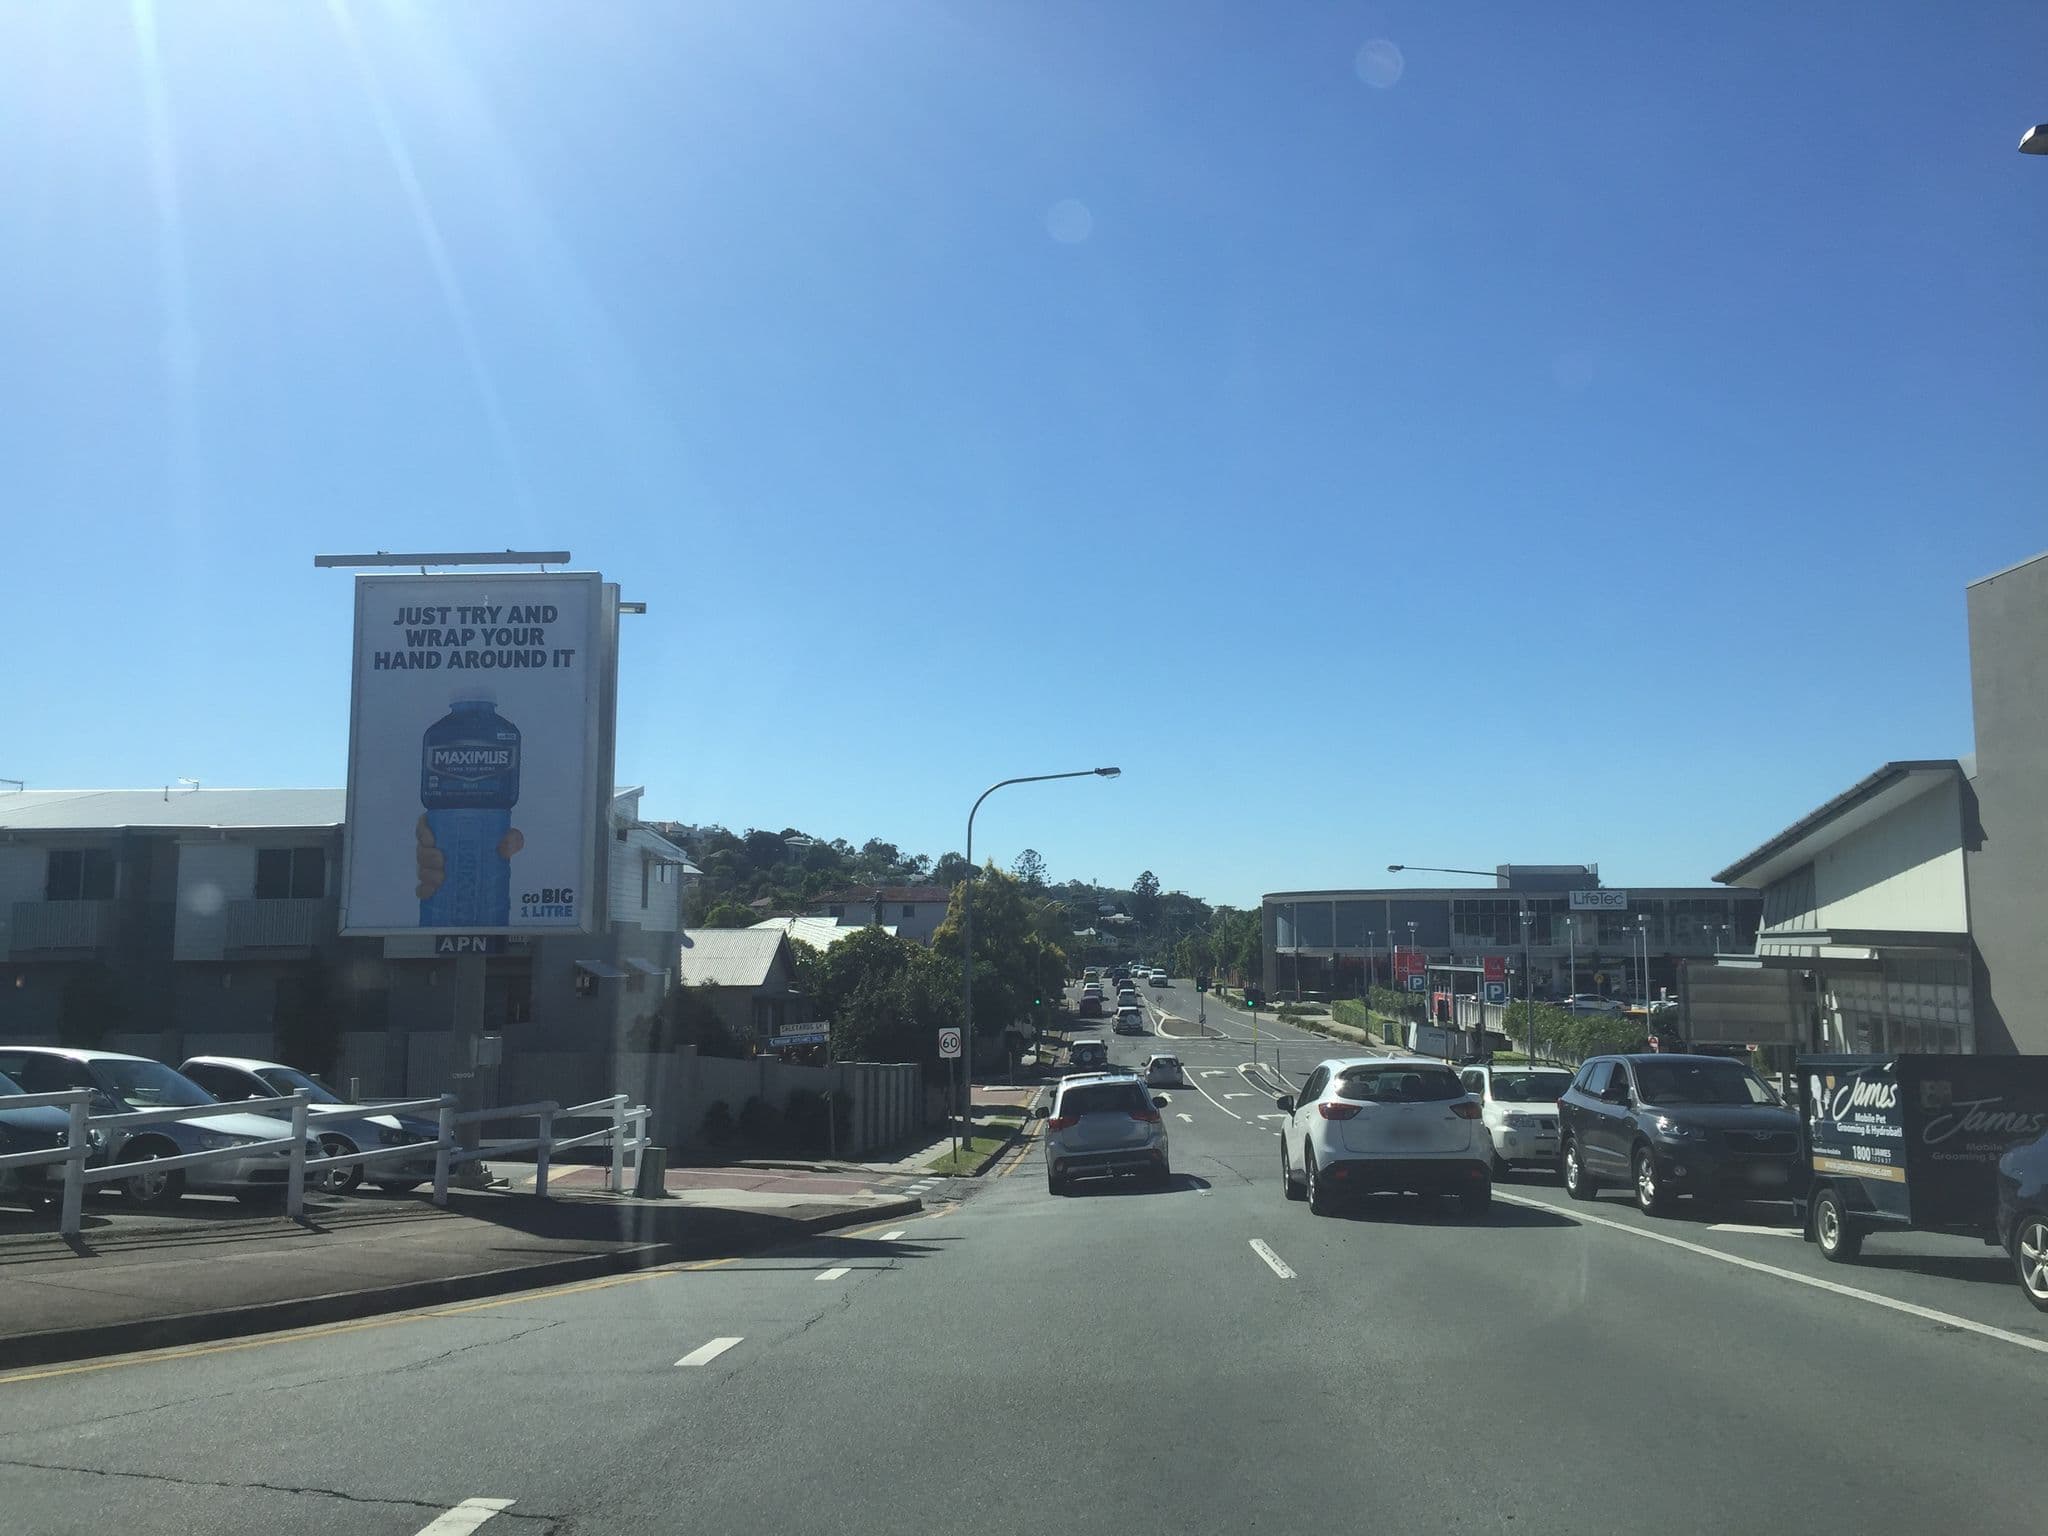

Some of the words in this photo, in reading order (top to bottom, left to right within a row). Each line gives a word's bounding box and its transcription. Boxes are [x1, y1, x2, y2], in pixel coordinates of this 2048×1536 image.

[393, 606, 452, 626] JUST
[456, 606, 503, 625] TRY
[507, 605, 559, 624] AND
[405, 628, 476, 647] WRAP
[481, 627, 545, 646] YOUR
[374, 651, 442, 670] HAND
[447, 649, 547, 670] AROUND
[552, 649, 576, 668] IT
[434, 750, 509, 765] MAXIMUS
[521, 893, 540, 904] GO
[541, 887, 574, 904] BIG
[1573, 891, 1625, 905] LifeTec
[520, 905, 529, 918] 1
[532, 905, 574, 917] LITRE
[439, 936, 488, 952] APN
[942, 1037, 958, 1048] 60
[1832, 1074, 1898, 1121] James
[1854, 1112, 1875, 1123] Mobile
[1922, 1096, 2046, 1145] James
[1836, 1122, 1865, 1136] Grooming
[1852, 1145, 1871, 1162] 1800
[1932, 1152, 1987, 1162] Grooming
